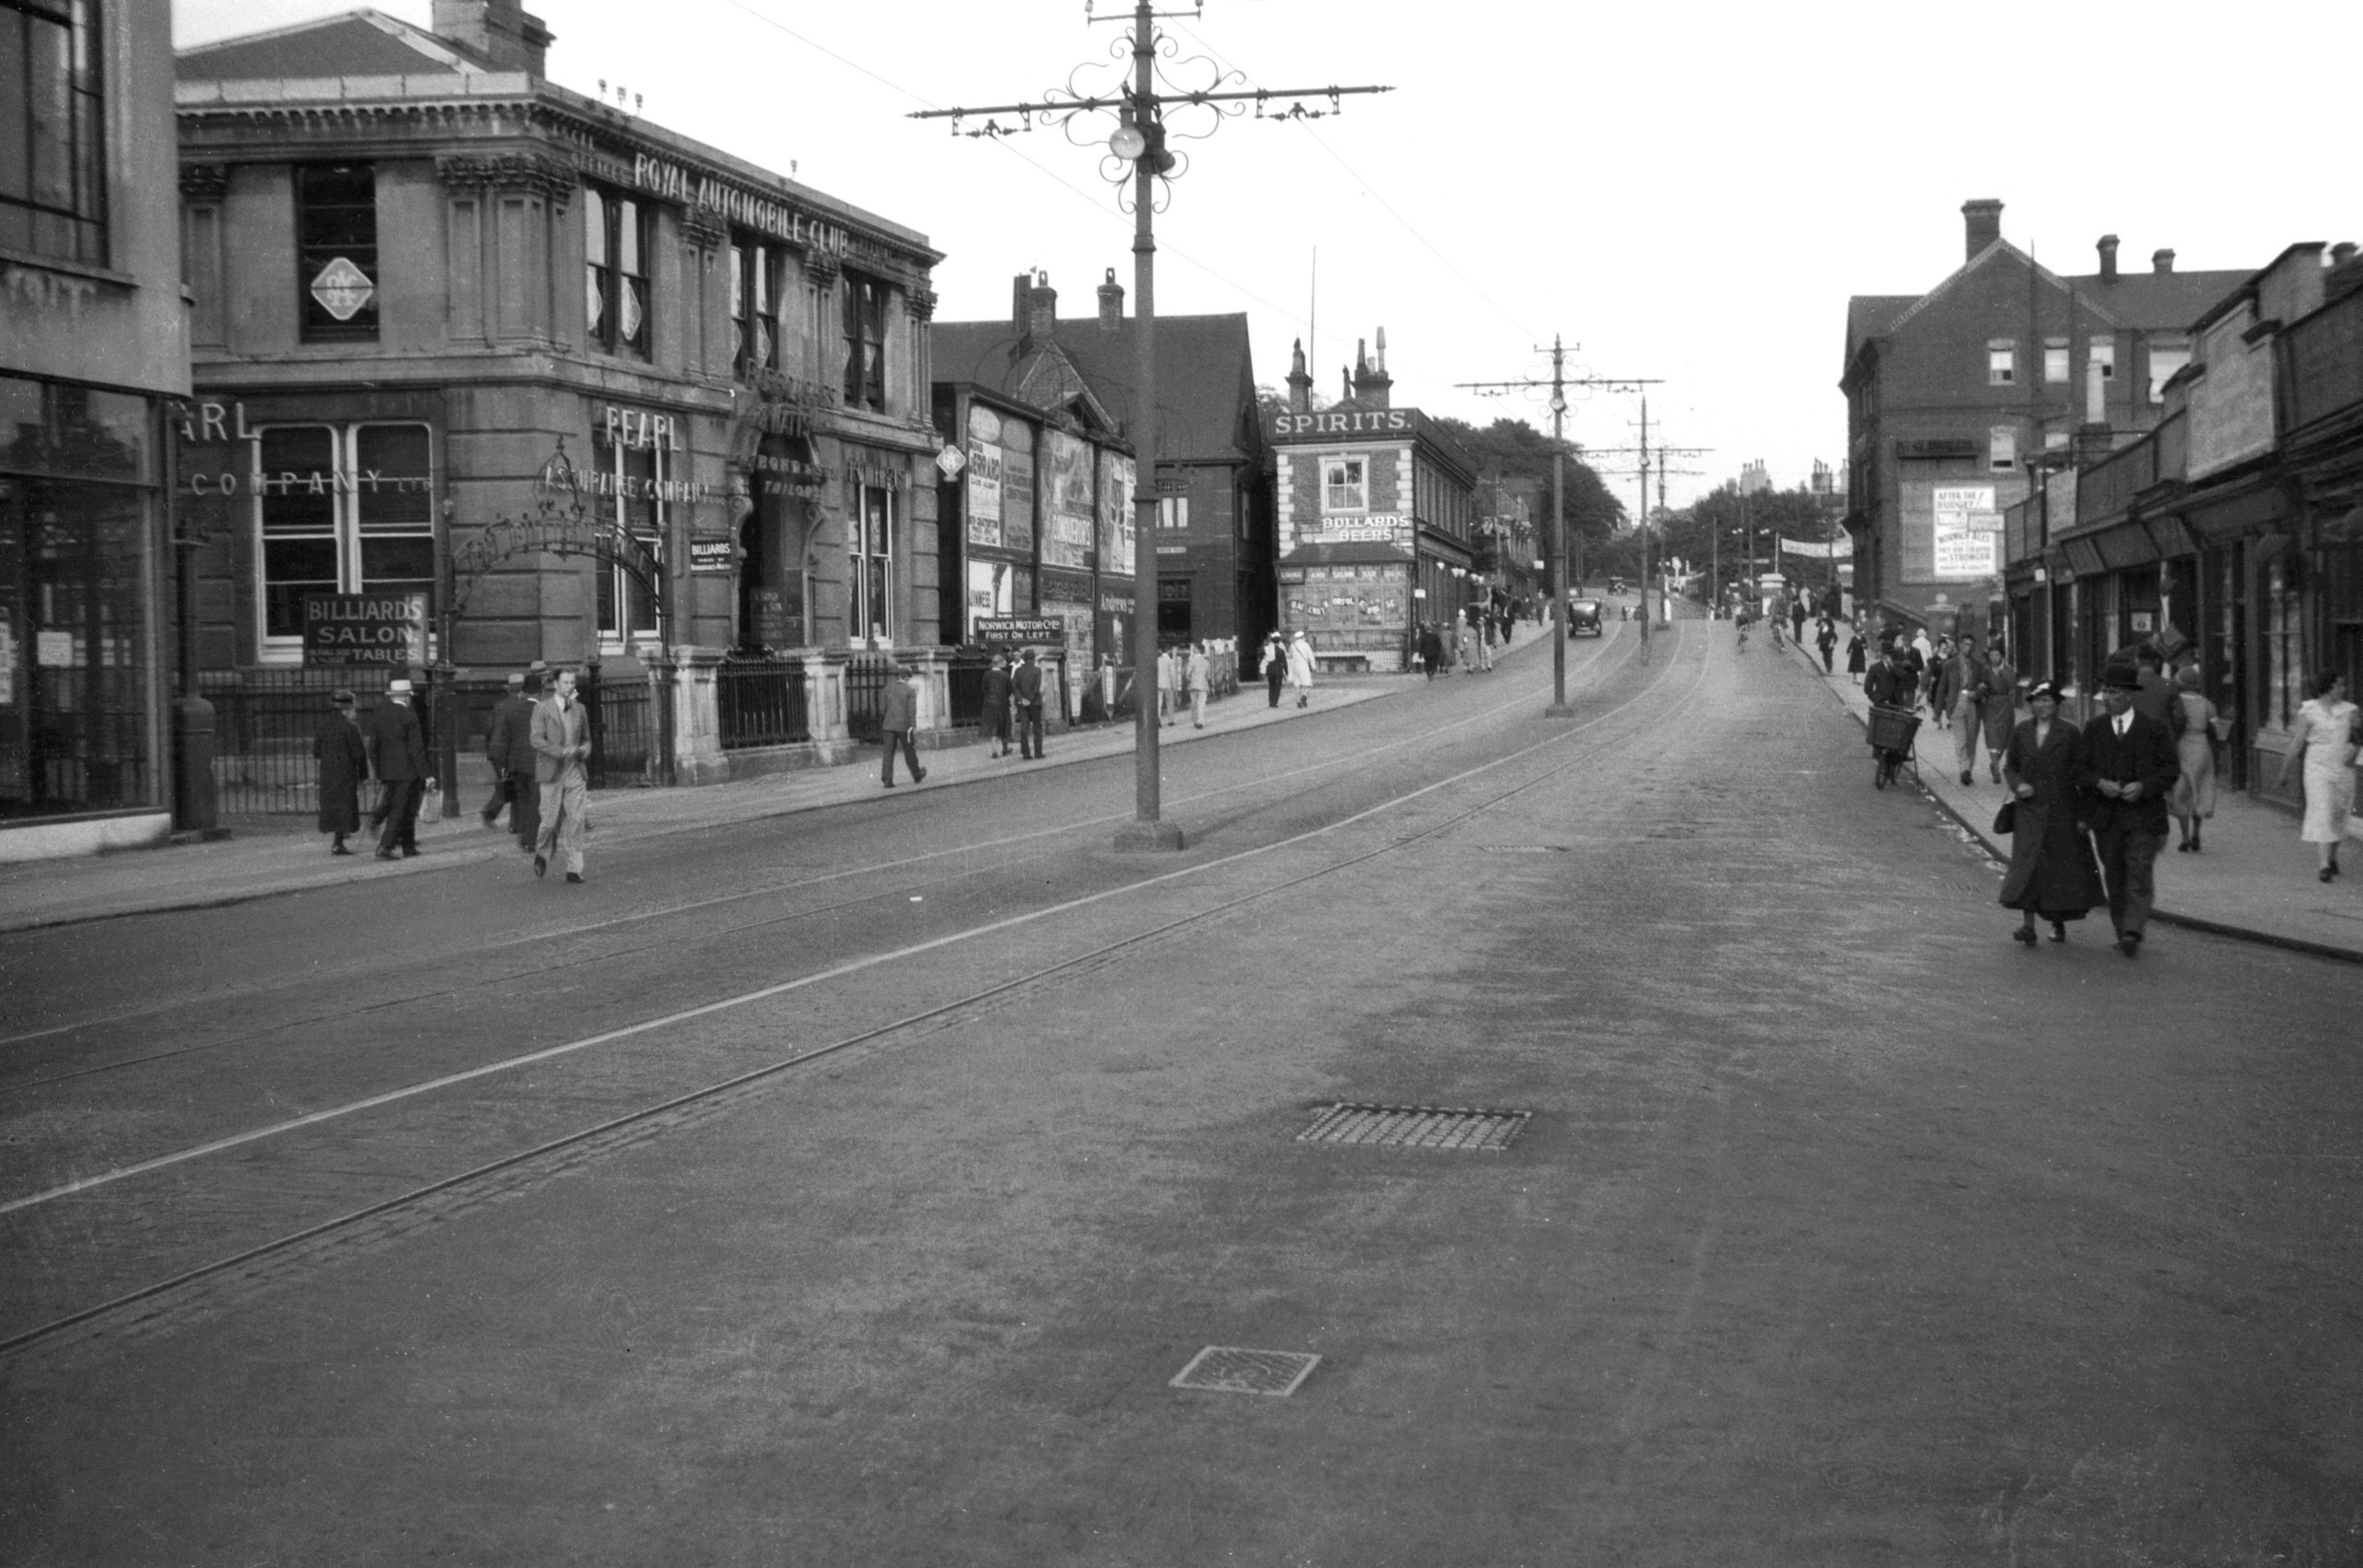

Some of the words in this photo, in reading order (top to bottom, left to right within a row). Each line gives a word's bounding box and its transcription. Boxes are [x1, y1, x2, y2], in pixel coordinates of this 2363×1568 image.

[635, 152, 690, 203] ROYAL
[697, 177, 803, 243] AUTOMOBILE
[809, 219, 848, 259] CLUB
[606, 405, 681, 451] PEARL
[1275, 411, 1412, 434] SPIRITS.
[757, 454, 800, 474] BOND
[192, 469, 381, 496] COMPANY
[1938, 492, 1961, 500] AFTER
[1322, 516, 1409, 528] BULLARDS
[1340, 529, 1392, 541] BEERS
[692, 543, 731, 554] BILLIARDS
[308, 600, 423, 621] BILLIARDS
[978, 620, 1013, 631] NORWICH
[1015, 620, 1042, 631] MOTOR
[985, 632, 1009, 640] FIRST
[1012, 631, 1024, 640] ON
